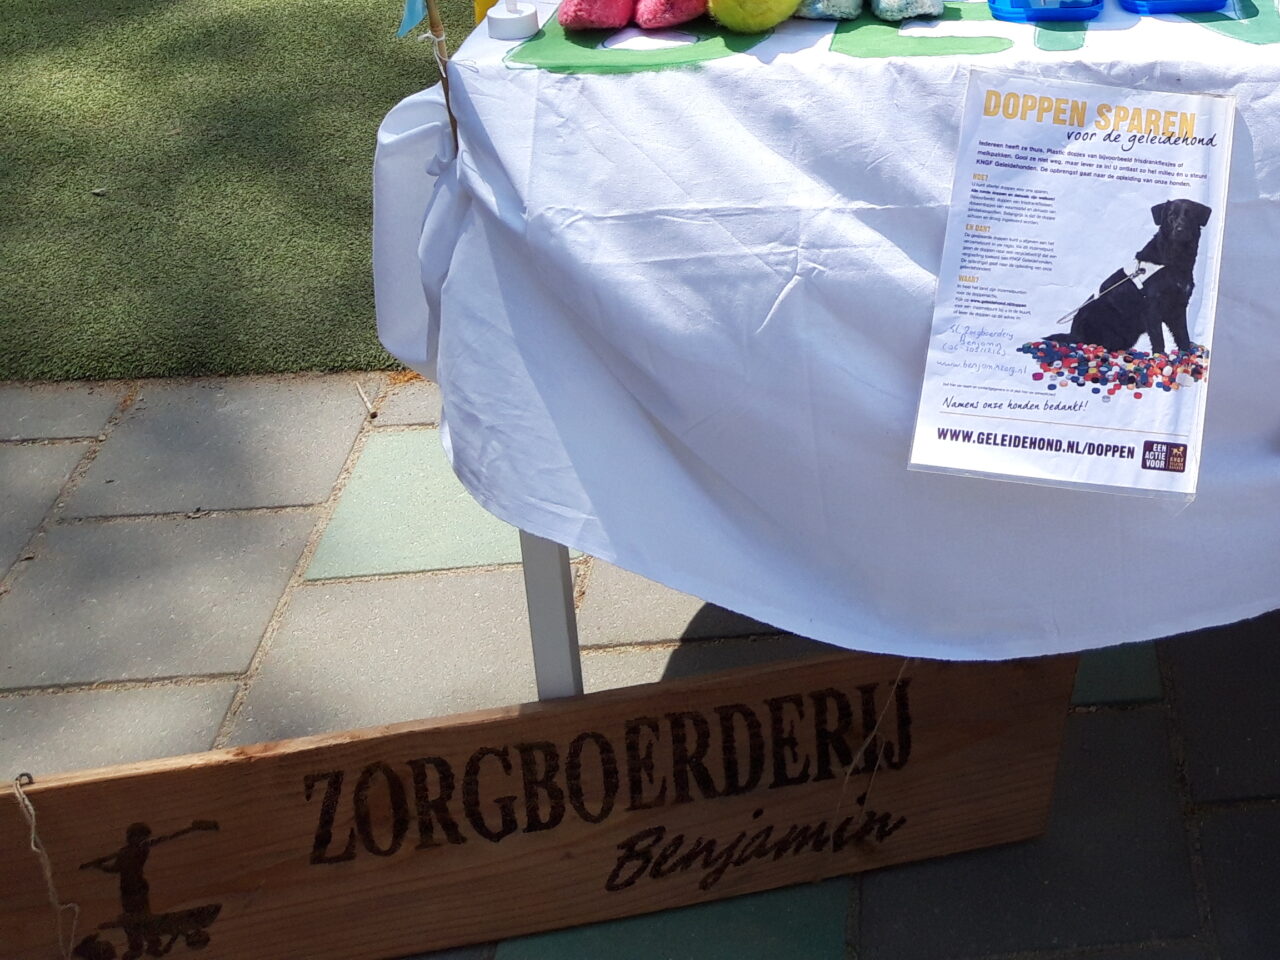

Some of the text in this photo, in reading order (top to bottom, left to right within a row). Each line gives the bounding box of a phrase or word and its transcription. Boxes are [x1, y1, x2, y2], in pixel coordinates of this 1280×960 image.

[983, 89, 1196, 139] DOPPEN SPAREN
[1066, 129, 1217, 152] voor de geleidehond
[943, 396, 1089, 411] Namens onze honden bedankt!
[937, 427, 1135, 460] WWW.GELEIDEHOND.NL/DOPPEN
[1153, 443, 1167, 452] EEN
[1145, 451, 1166, 460] ACTIE
[1146, 459, 1165, 468] VOOR
[303, 681, 913, 866] ZORGBOERDERIJ
[604, 792, 907, 892] Benjamin
